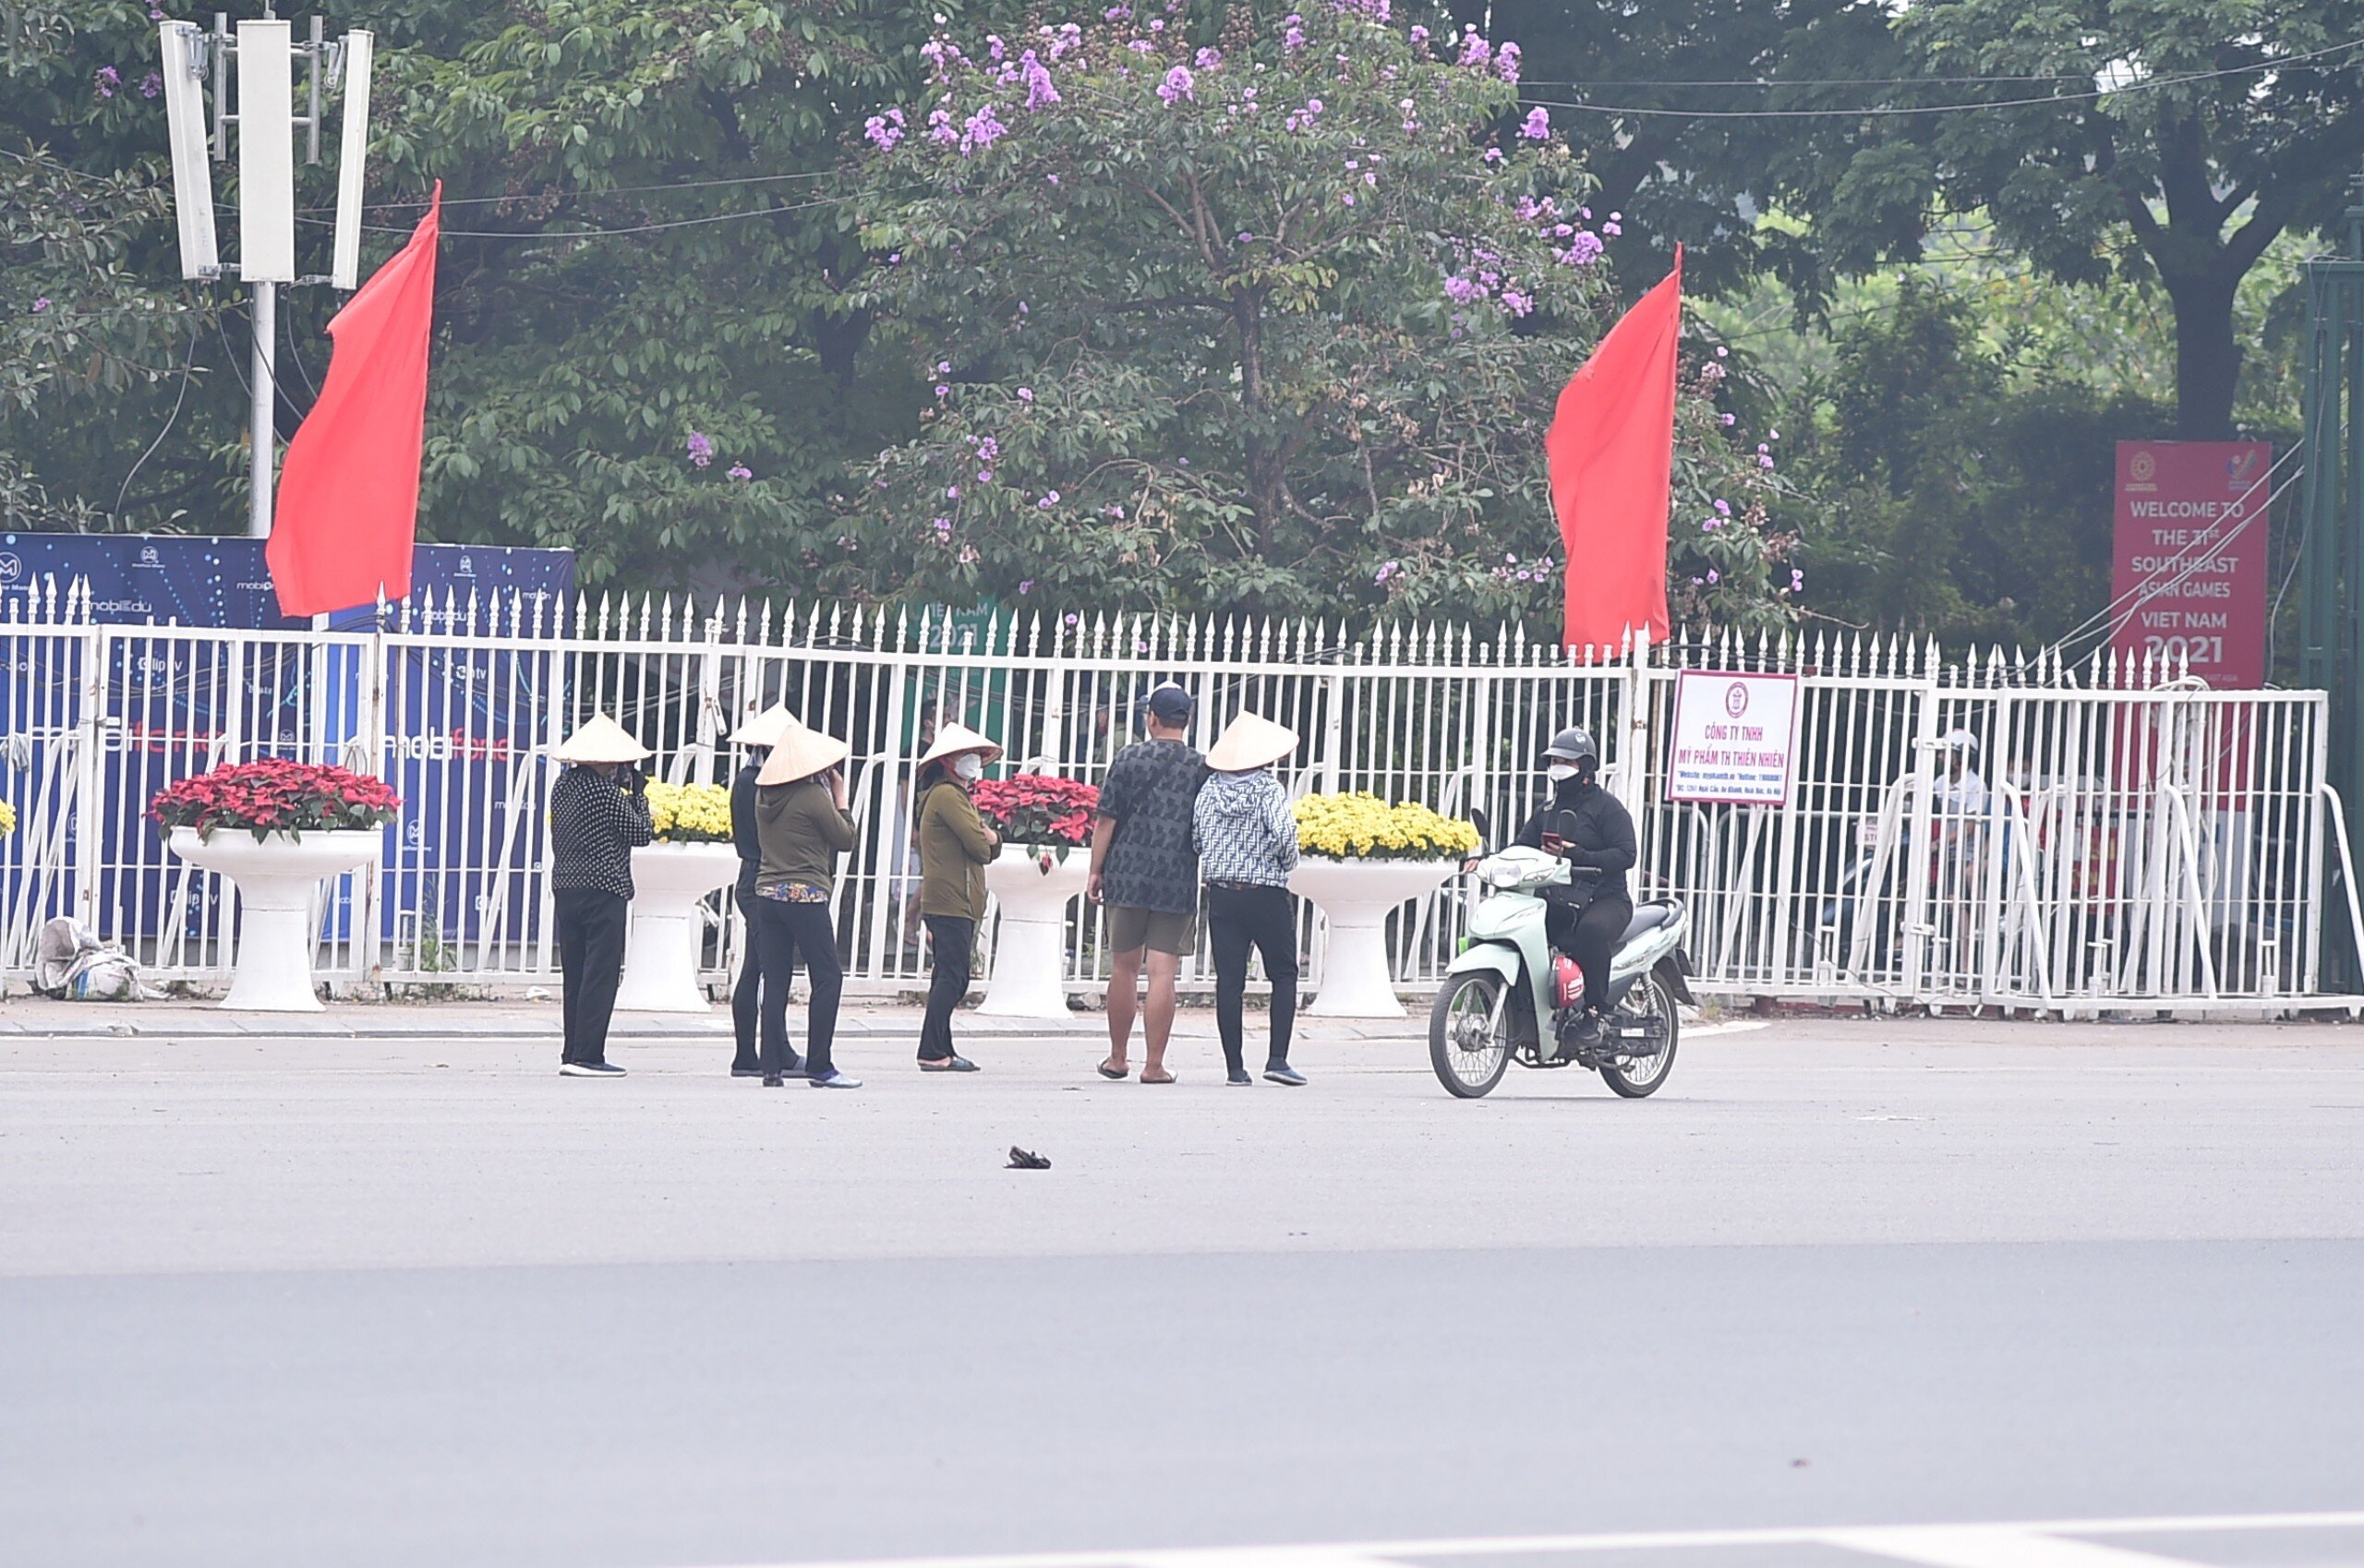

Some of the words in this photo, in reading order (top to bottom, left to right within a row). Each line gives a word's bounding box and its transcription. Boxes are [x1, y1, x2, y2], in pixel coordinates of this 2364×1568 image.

[2129, 501, 2217, 517] WELCOME
[2221, 501, 2245, 518] TO
[2152, 529, 2188, 545] THE
[2131, 556, 2239, 573] SOUTHEAST
[2139, 581, 2179, 597] ASIAN
[2182, 582, 2231, 597] GAMES
[2141, 612, 2181, 628] VIET
[2185, 612, 2227, 628] NAM
[2143, 635, 2223, 663] 2021
[1730, 726, 1740, 741] TY
[1742, 726, 1764, 741] TNHH
[1720, 751, 1731, 766] TH
